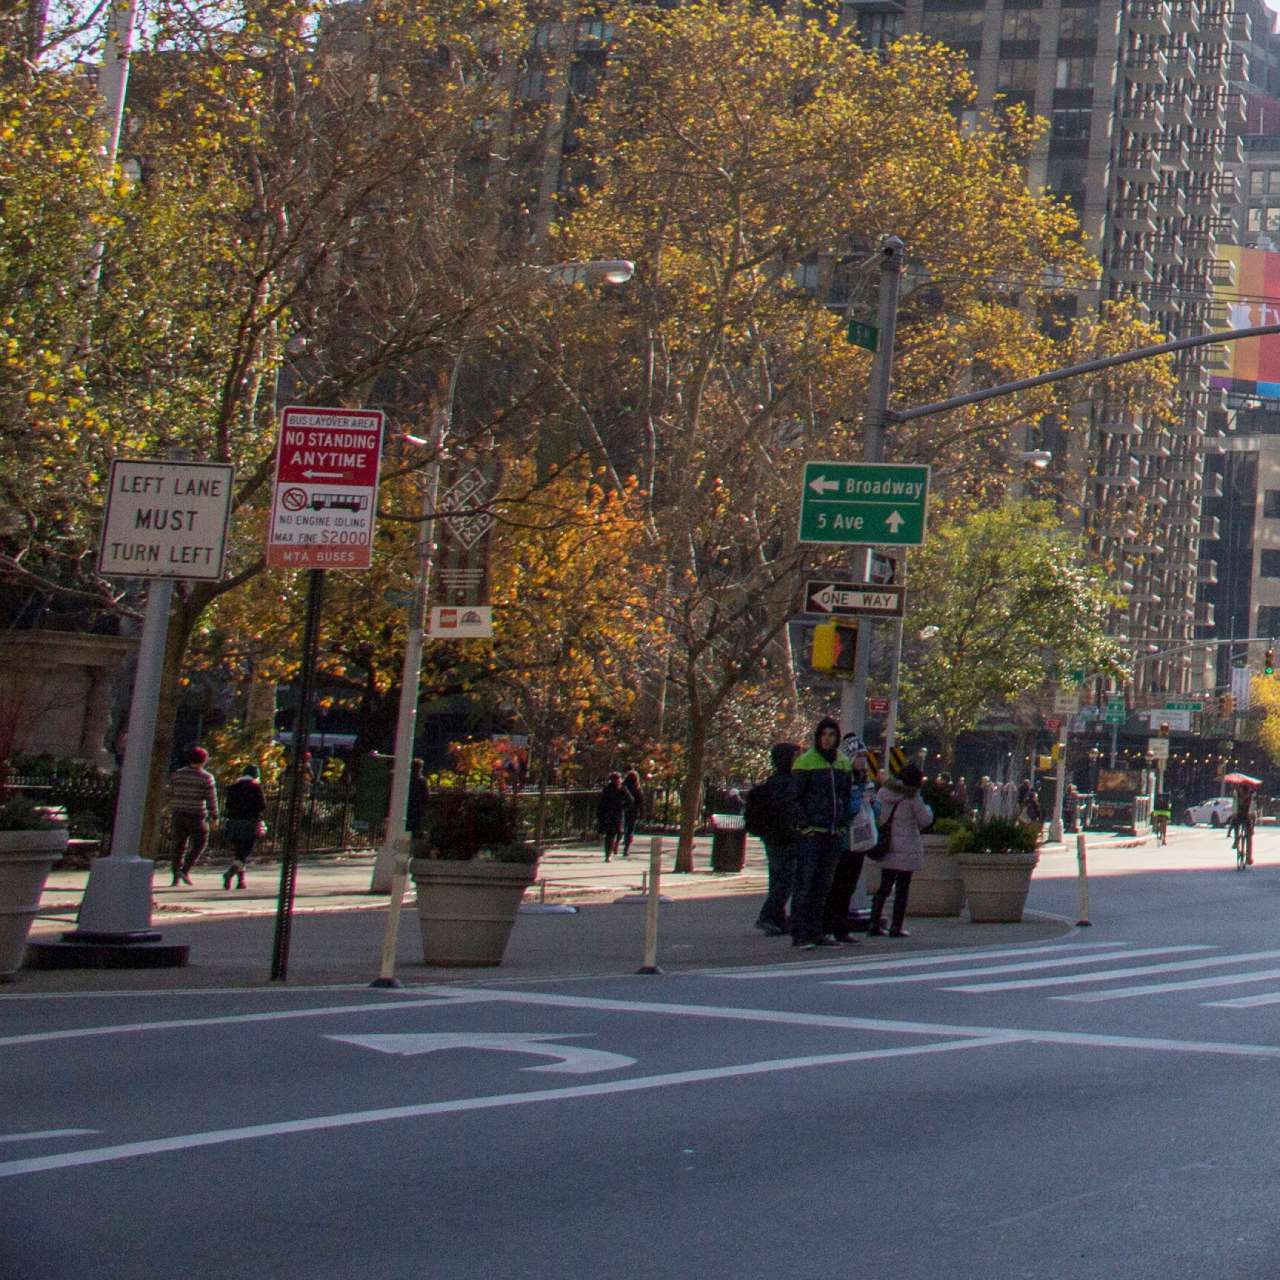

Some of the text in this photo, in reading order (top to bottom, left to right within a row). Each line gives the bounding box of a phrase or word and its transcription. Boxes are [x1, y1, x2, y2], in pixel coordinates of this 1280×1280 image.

[286, 431, 376, 449] NO STANDING
[290, 451, 367, 468] ANYTIME
[120, 475, 221, 497] LEFT LANE
[846, 478, 923, 499] Broadway
[135, 508, 198, 531] MUST
[280, 515, 365, 528] NO ENGINE IDLING
[818, 513, 864, 529] 5 Ave
[112, 542, 214, 564] TURN LEFT
[283, 552, 355, 562] MTA BUSES
[822, 592, 891, 607] ONE WAY
